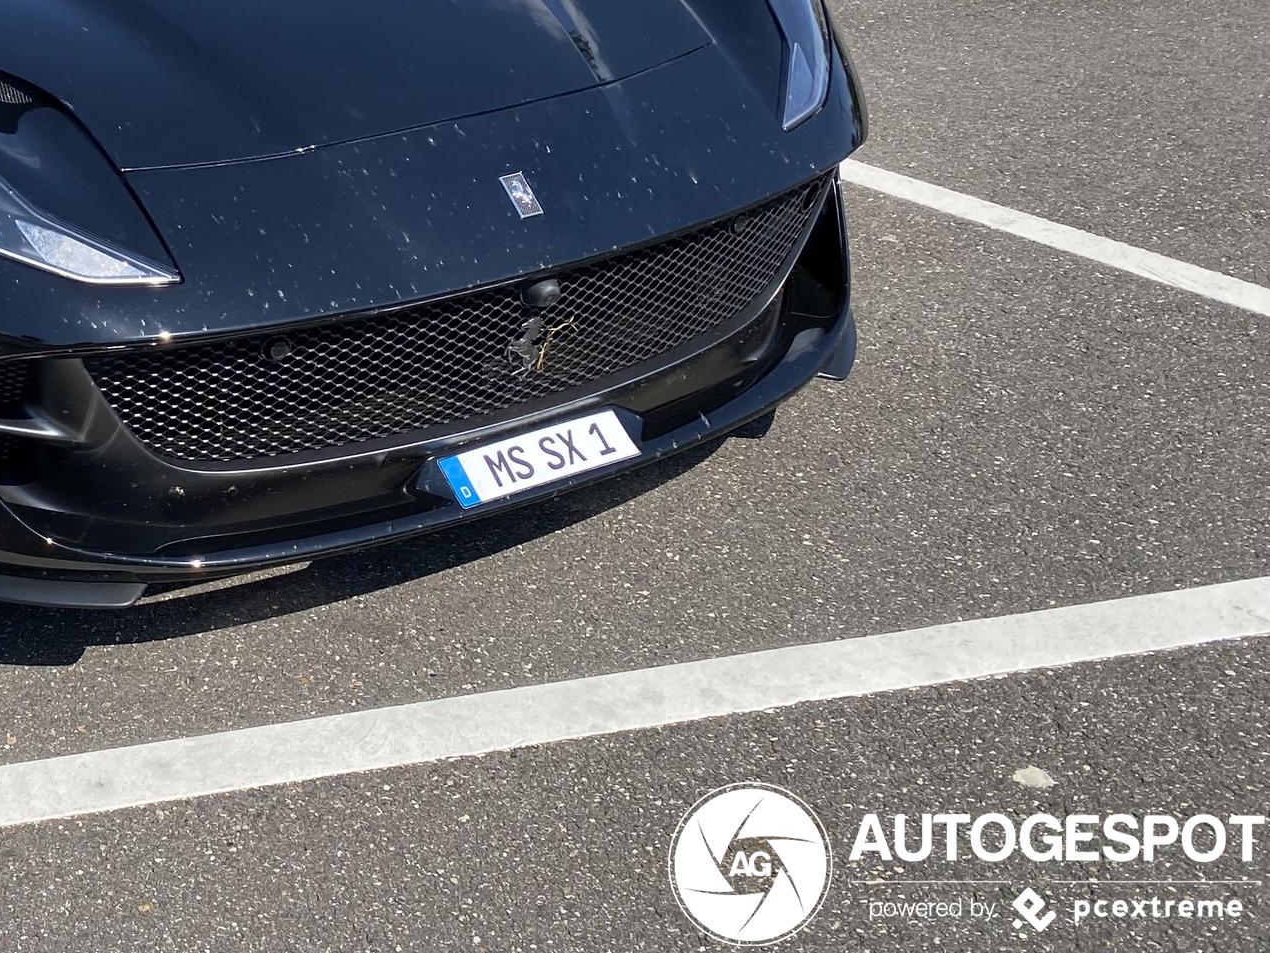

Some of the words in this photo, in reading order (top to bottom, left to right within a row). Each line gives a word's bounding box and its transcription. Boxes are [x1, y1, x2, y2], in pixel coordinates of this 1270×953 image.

[483, 445, 535, 488] MS
[538, 429, 587, 470] SX
[588, 423, 617, 456] 1
[460, 485, 472, 499] D
